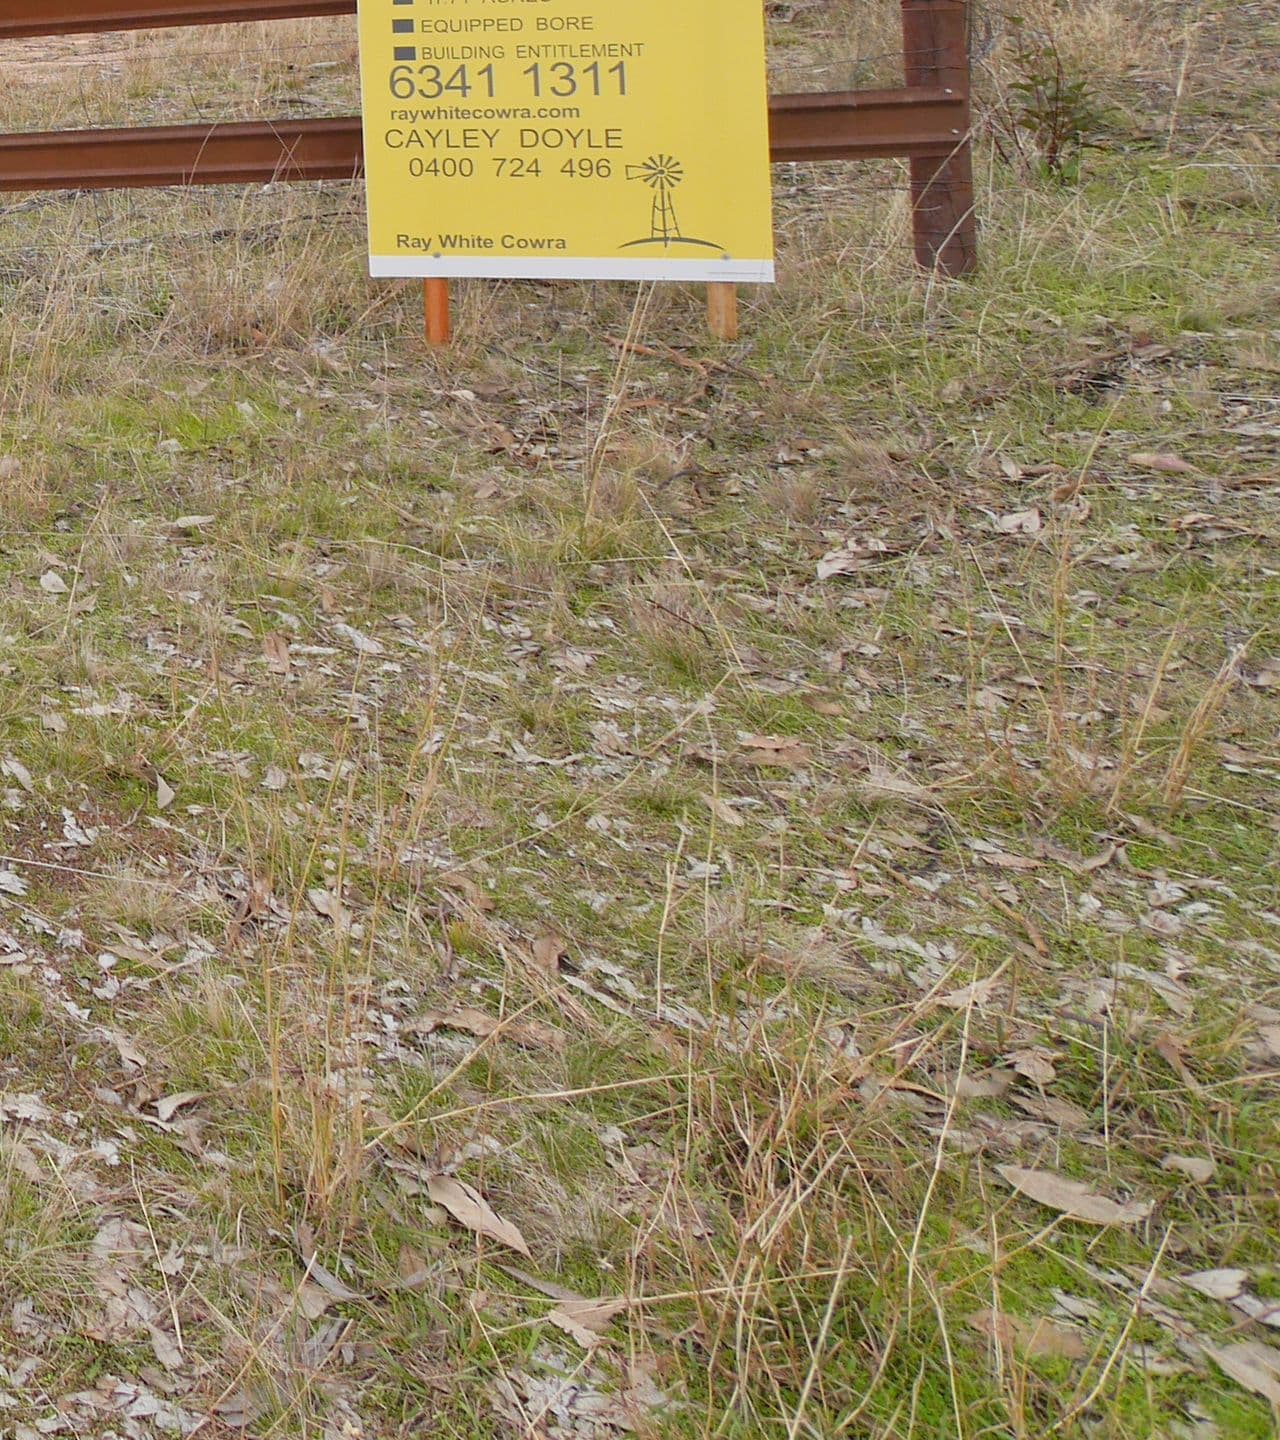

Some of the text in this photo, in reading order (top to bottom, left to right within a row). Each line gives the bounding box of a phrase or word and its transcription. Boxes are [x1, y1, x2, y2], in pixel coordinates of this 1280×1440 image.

[420, 16, 594, 34] EQUIPPED BORE
[421, 42, 645, 61] BUILDING ENTITLEMENT
[388, 61, 628, 100] 6341 1311
[390, 104, 581, 123] raywhitecowra.com
[384, 128, 624, 150] CAYLEY DOYLE
[408, 157, 613, 179] 0400 724 496
[396, 234, 567, 252] Ray White Cowra
